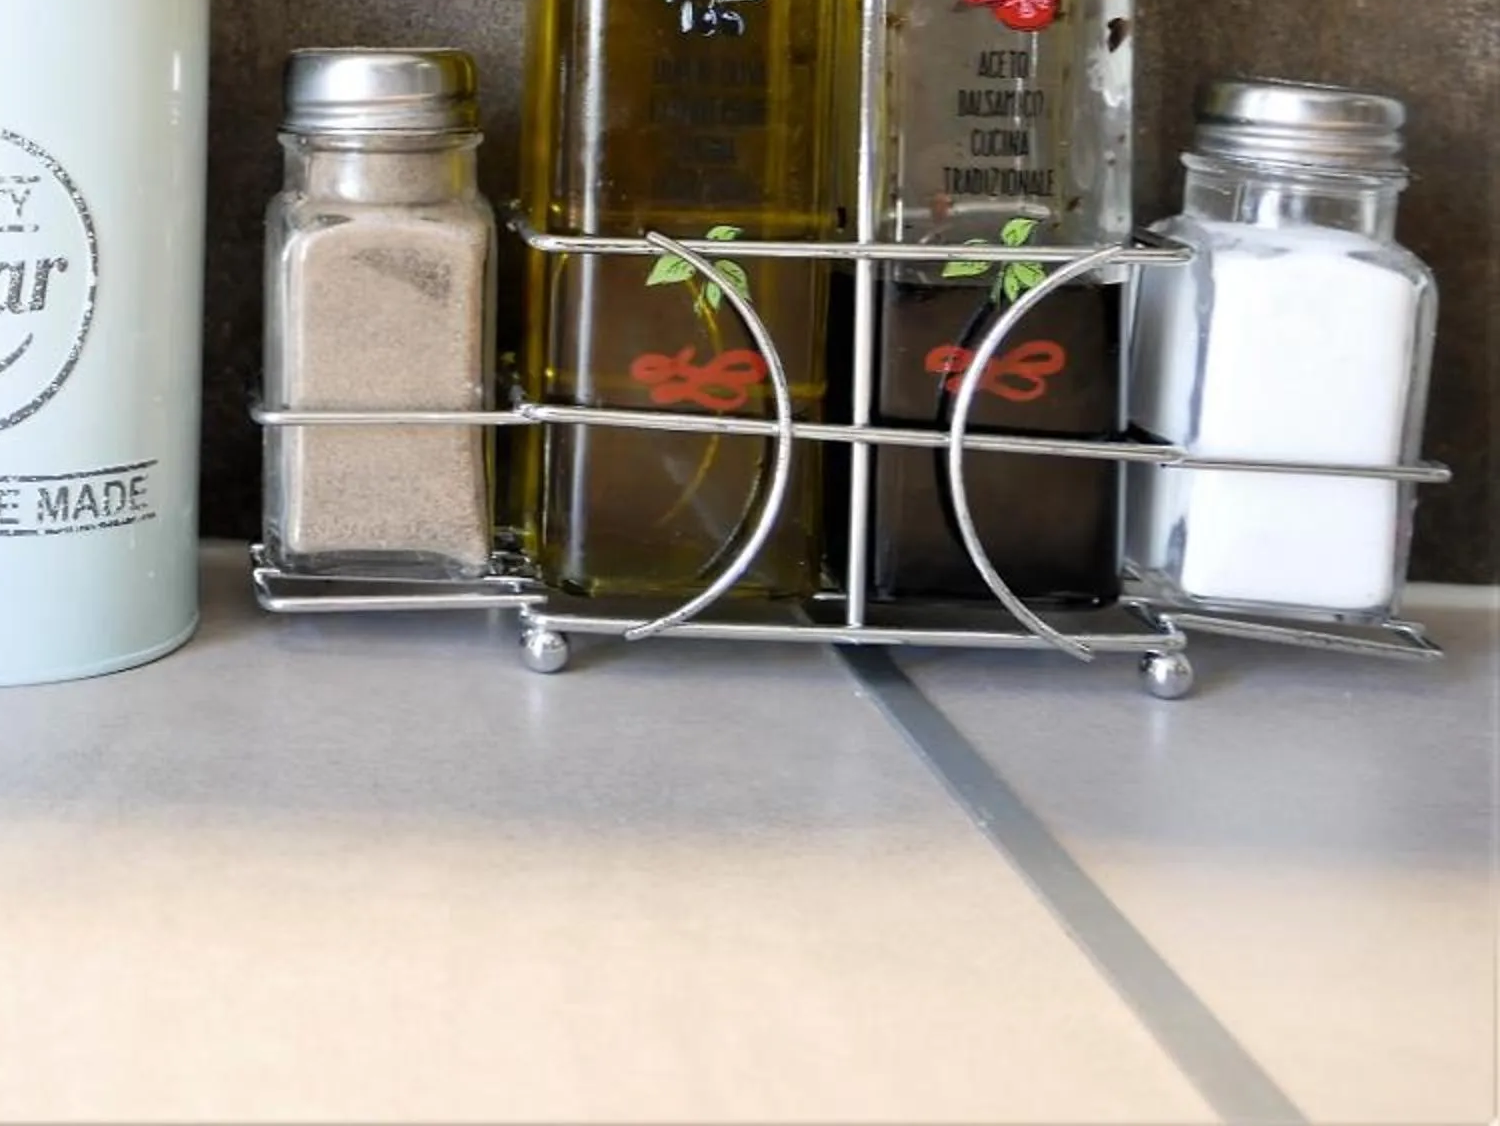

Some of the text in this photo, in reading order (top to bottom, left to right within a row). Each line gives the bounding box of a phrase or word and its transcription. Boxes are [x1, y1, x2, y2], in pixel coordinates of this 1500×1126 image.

[977, 50, 1029, 78] ACETO
[970, 128, 1030, 157] CUCINA
[942, 166, 1057, 197] TRADIZIONALE
[36, 475, 149, 524] MADE
